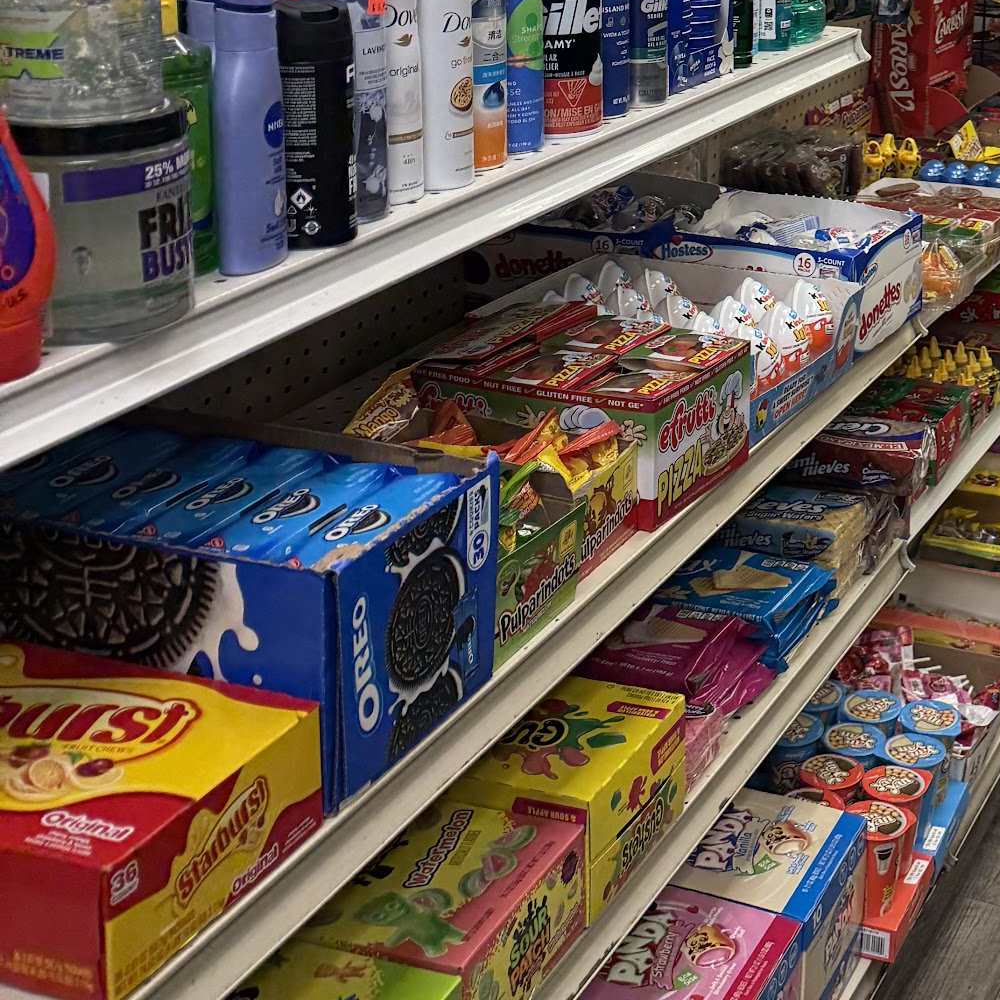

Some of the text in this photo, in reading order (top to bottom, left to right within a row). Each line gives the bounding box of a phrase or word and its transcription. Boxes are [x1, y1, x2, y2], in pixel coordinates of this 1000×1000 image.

[385, 4, 417, 28] Dov
[389, 63, 419, 78] original
[451, 58, 462, 67] go
[146, 160, 174, 179] 25%
[596, 239, 609, 250] 16
[661, 243, 708, 258] Hostess
[797, 257, 812, 269] 16
[817, 257, 845, 268] 3-COUNT
[859, 282, 901, 342] donettes
[605, 331, 635, 350] PIZZA
[689, 345, 719, 365] PIZZA
[428, 371, 448, 380] FREE
[450, 375, 470, 384] FOOD
[484, 380, 499, 389] NUT
[501, 383, 522, 393] FREE
[537, 390, 569, 401] GLUTEN
[571, 394, 593, 403] FREE
[608, 399, 624, 408] NOT
[546, 363, 582, 387] PIZZA
[638, 376, 667, 395] PIZZA
[355, 407, 399, 437] Mango
[658, 385, 715, 453] efrutti
[658, 438, 701, 517] PIZZA
[802, 460, 851, 477] nieves
[184, 477, 245, 511] OREO
[252, 487, 310, 525] OREO
[323, 504, 379, 541] OREO
[580, 491, 633, 564] ulparindots
[747, 510, 825, 521] Sugar Wafers
[471, 536, 486, 565] 30
[724, 533, 773, 547] nieves
[500, 553, 576, 646] Pulparindots
[351, 597, 381, 733] OREO
[41, 811, 135, 842] Original
[528, 806, 553, 818] APPLE
[177, 778, 266, 901] Starburst
[403, 809, 474, 887] Watermelon
[735, 831, 752, 858] Vanilla
[111, 863, 138, 891] 36
[232, 843, 279, 895] Original
[510, 906, 549, 966] SOUR
[607, 912, 676, 986] PANDA
[510, 925, 551, 993] PATCH
[653, 932, 679, 978] Strawberry
